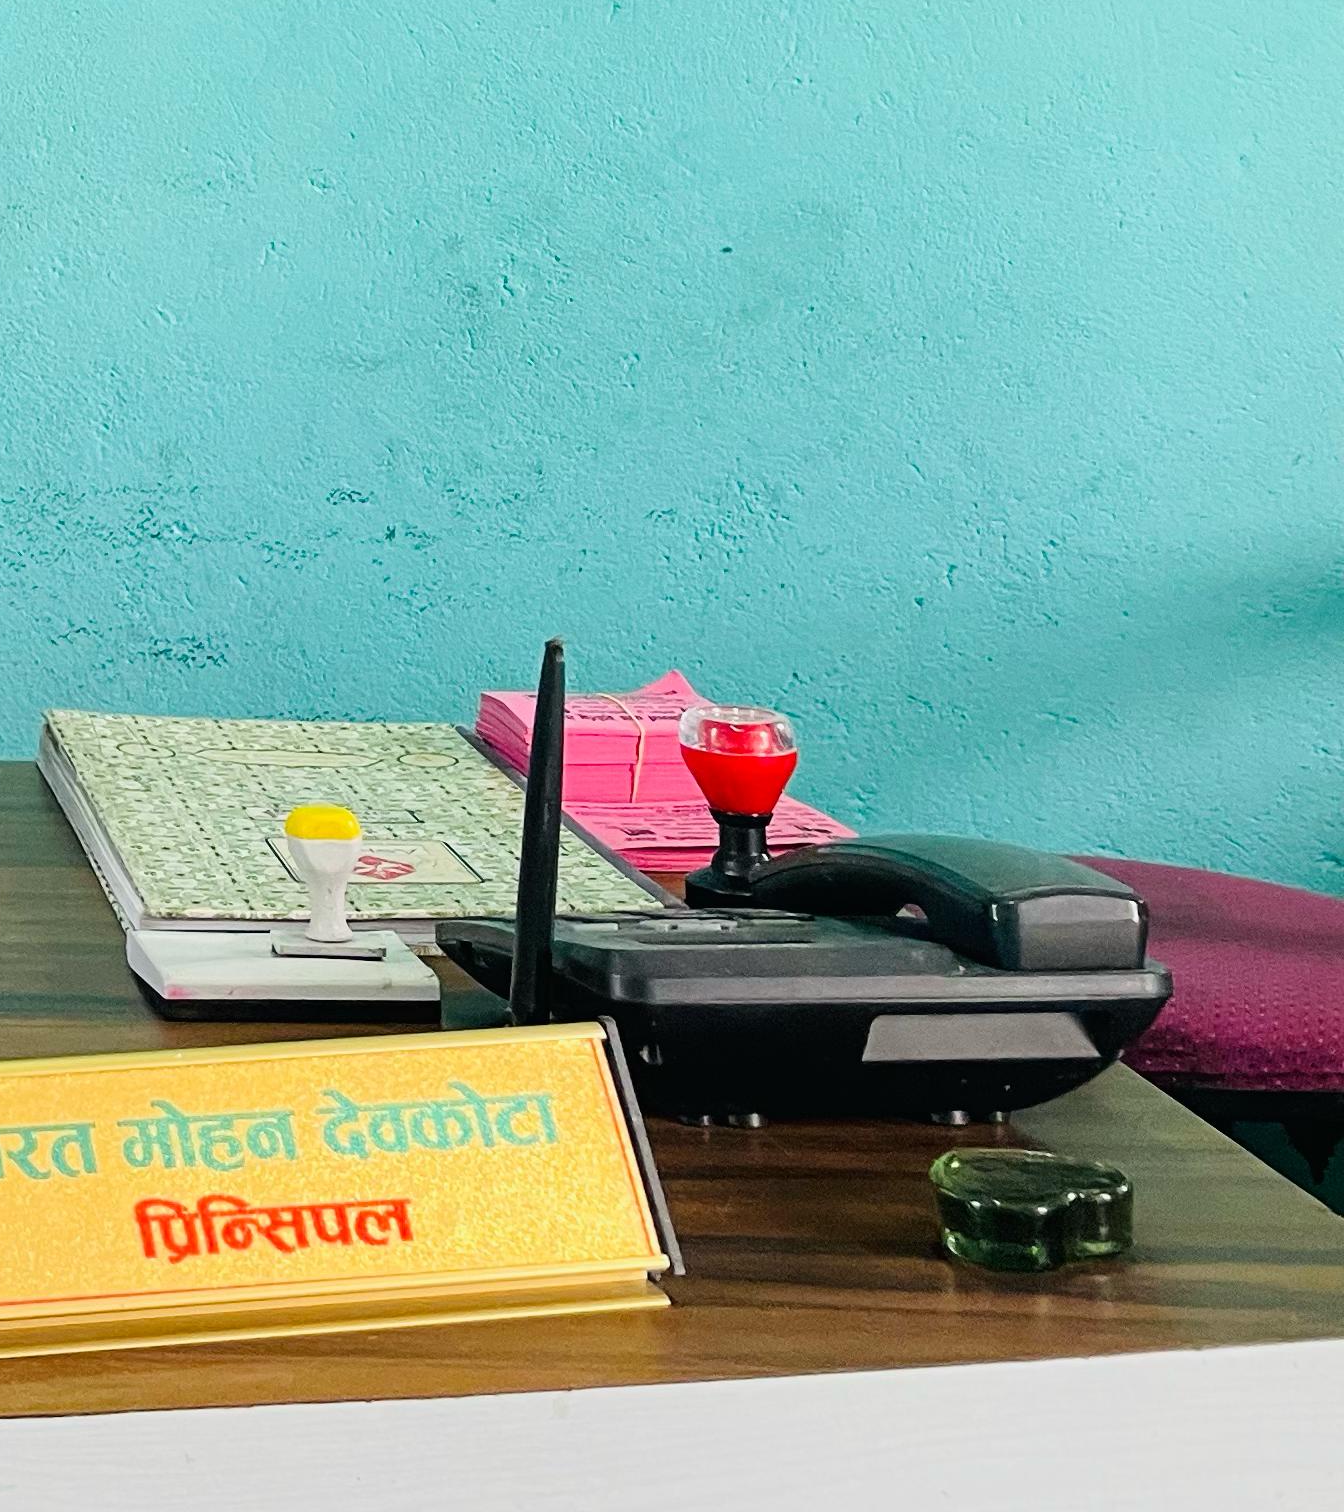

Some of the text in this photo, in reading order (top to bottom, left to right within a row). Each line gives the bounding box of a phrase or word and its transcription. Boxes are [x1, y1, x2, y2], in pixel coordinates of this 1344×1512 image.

[116, 1100, 296, 1171] मोहन
[318, 1081, 556, 1159] देवकोटा
[134, 1194, 413, 1261] प्रिन्सिपल
